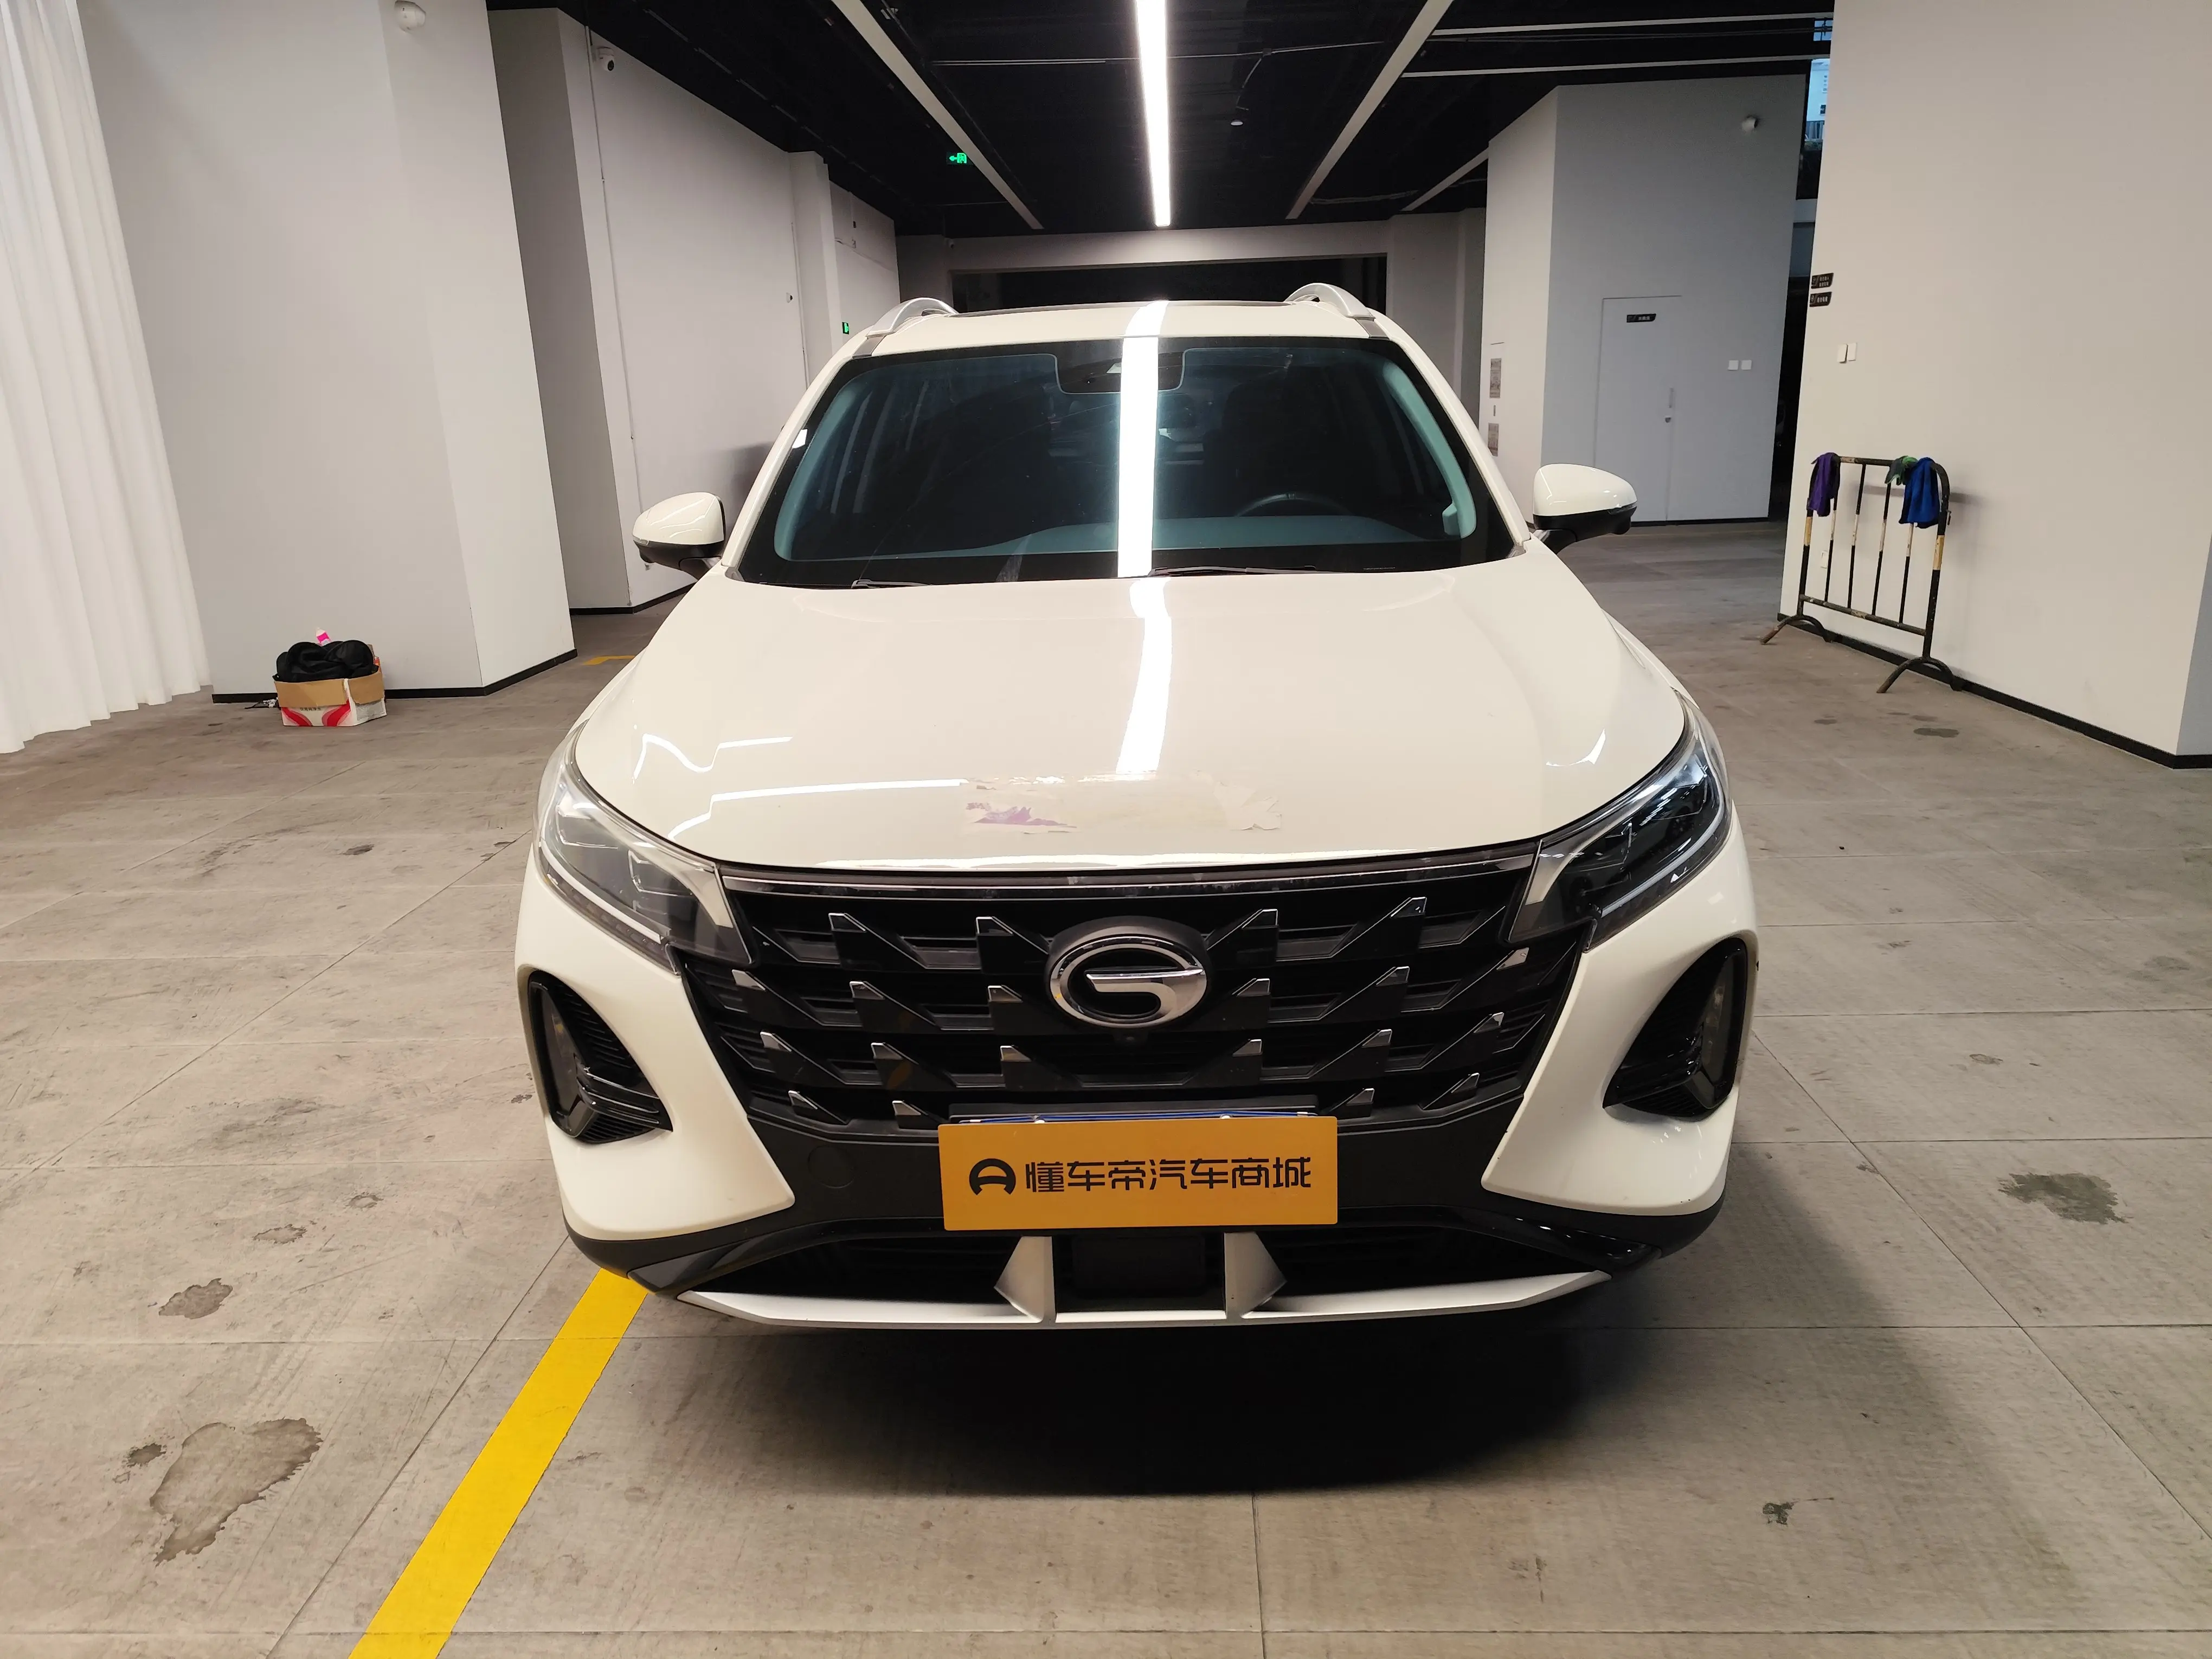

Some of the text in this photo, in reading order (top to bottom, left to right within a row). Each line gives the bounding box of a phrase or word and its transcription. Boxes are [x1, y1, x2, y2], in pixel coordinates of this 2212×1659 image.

[1025, 1156, 1311, 1193] 懂车帝汽车商城
